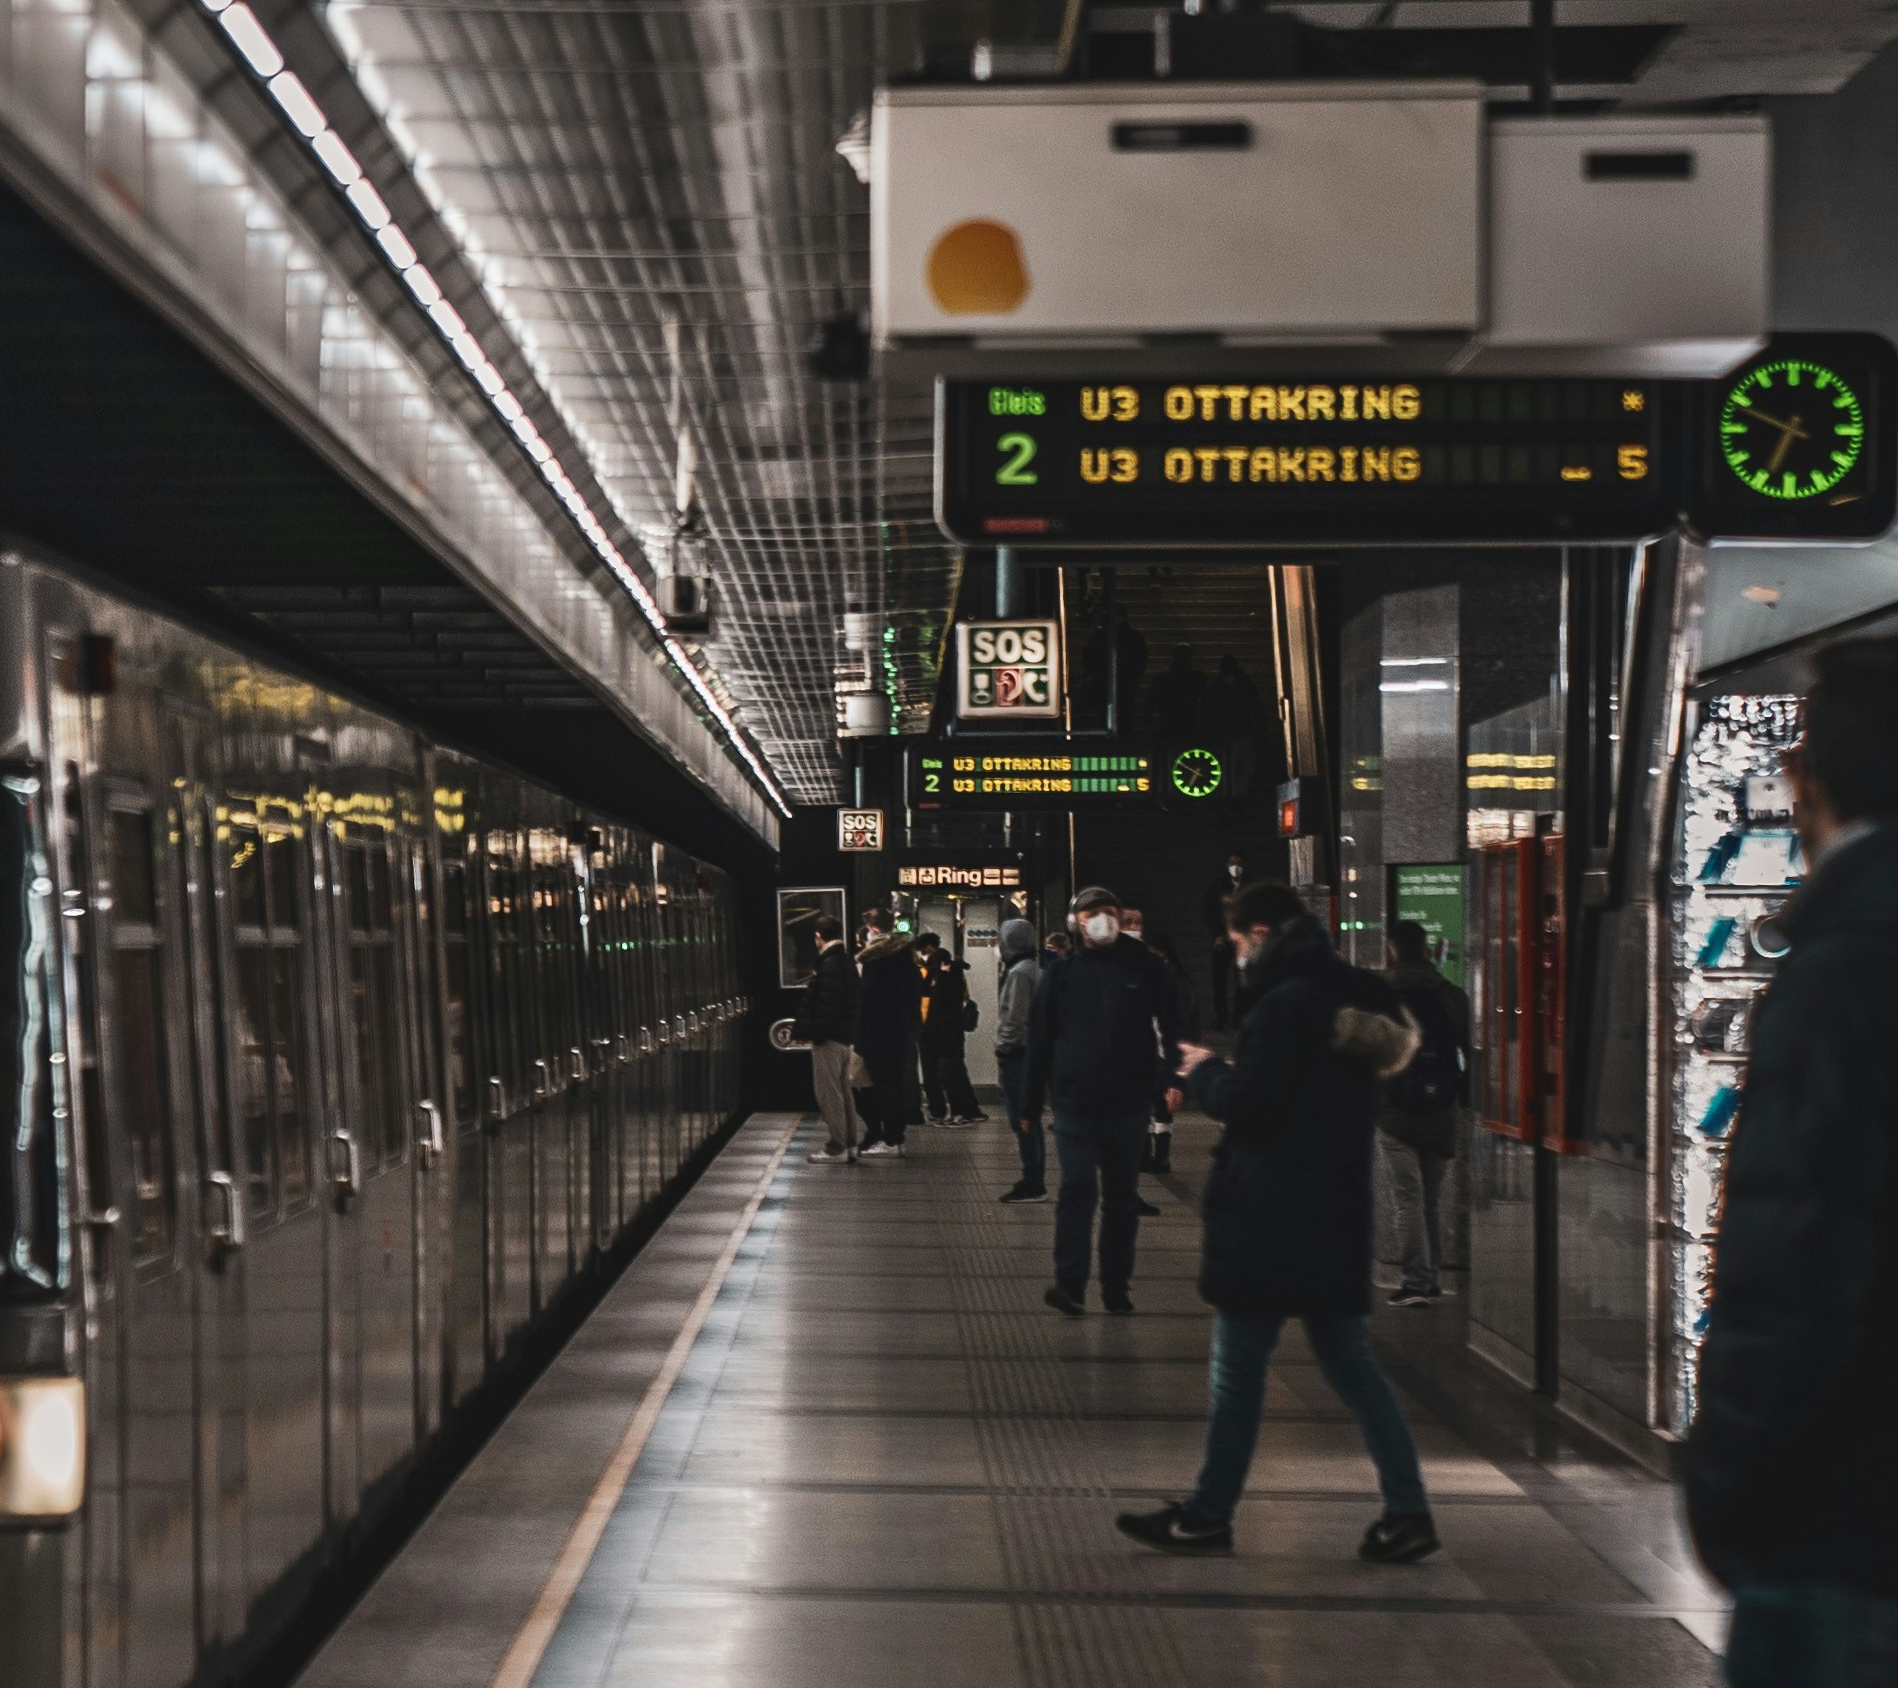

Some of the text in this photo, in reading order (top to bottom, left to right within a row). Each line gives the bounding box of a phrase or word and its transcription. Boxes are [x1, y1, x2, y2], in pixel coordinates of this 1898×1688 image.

[1079, 385, 1421, 422] U3 OTTAKRING
[995, 431, 1039, 485] 2
[1079, 443, 1649, 484] U3 OTTAKRING 5
[973, 630, 1045, 664] SOS
[953, 757, 1072, 771] U3 OTTAKRING
[924, 774, 940, 792] 2
[953, 778, 1149, 792] U3 OTTAKRING 5
[844, 815, 876, 830] SOS
[937, 866, 981, 888] Ring
